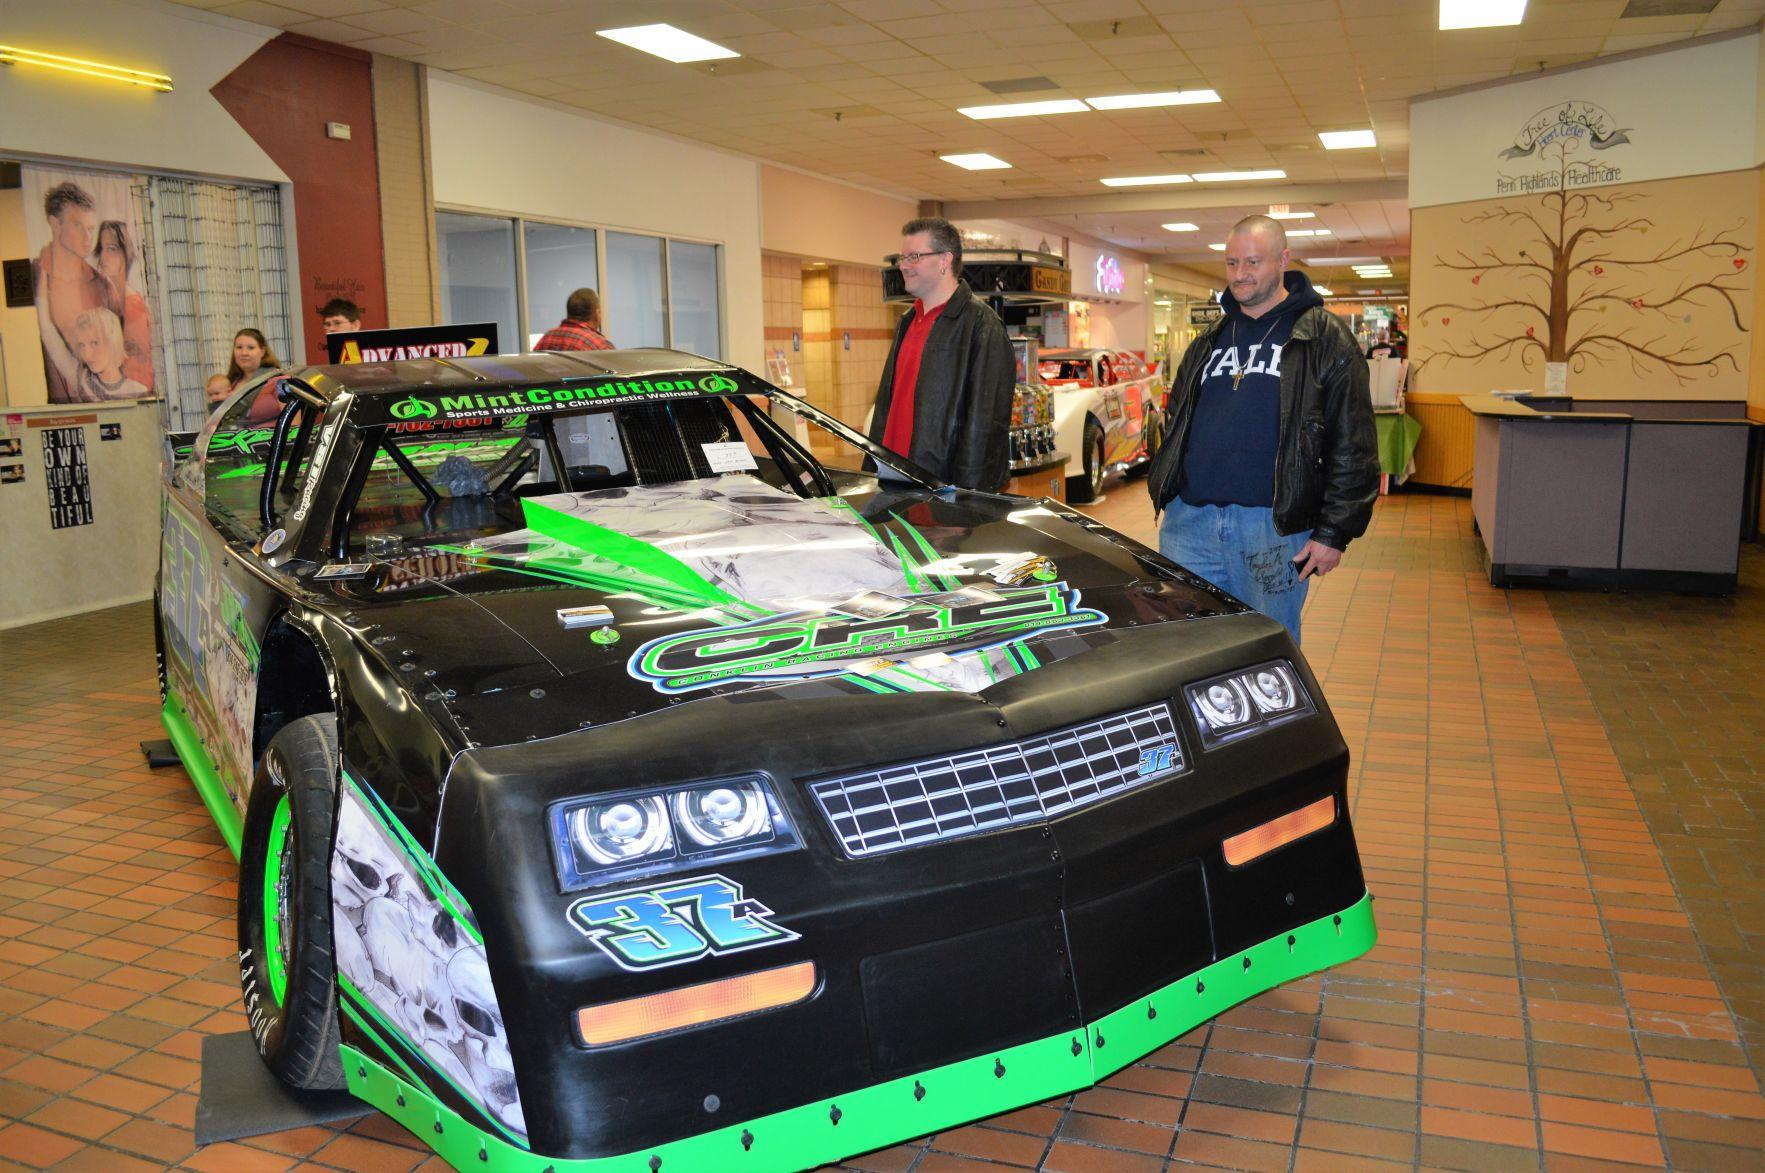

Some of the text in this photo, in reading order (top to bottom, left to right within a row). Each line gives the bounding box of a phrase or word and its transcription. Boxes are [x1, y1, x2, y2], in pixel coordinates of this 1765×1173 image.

[1521, 103, 1607, 146] Tree of Life
[1496, 166, 1622, 194] Penn Highlands Healthcare
[440, 379, 695, 411] MintCondition
[446, 390, 700, 418] Sports Medicine & Chiropractic Wellness
[42, 428, 85, 448] BE YOUR
[44, 446, 86, 469] OWN
[46, 465, 88, 488] KIND OF
[49, 485, 90, 507] BEAU
[51, 503, 93, 528] TIFUL
[678, 633, 957, 685] CONKLIN RACING ENGINES
